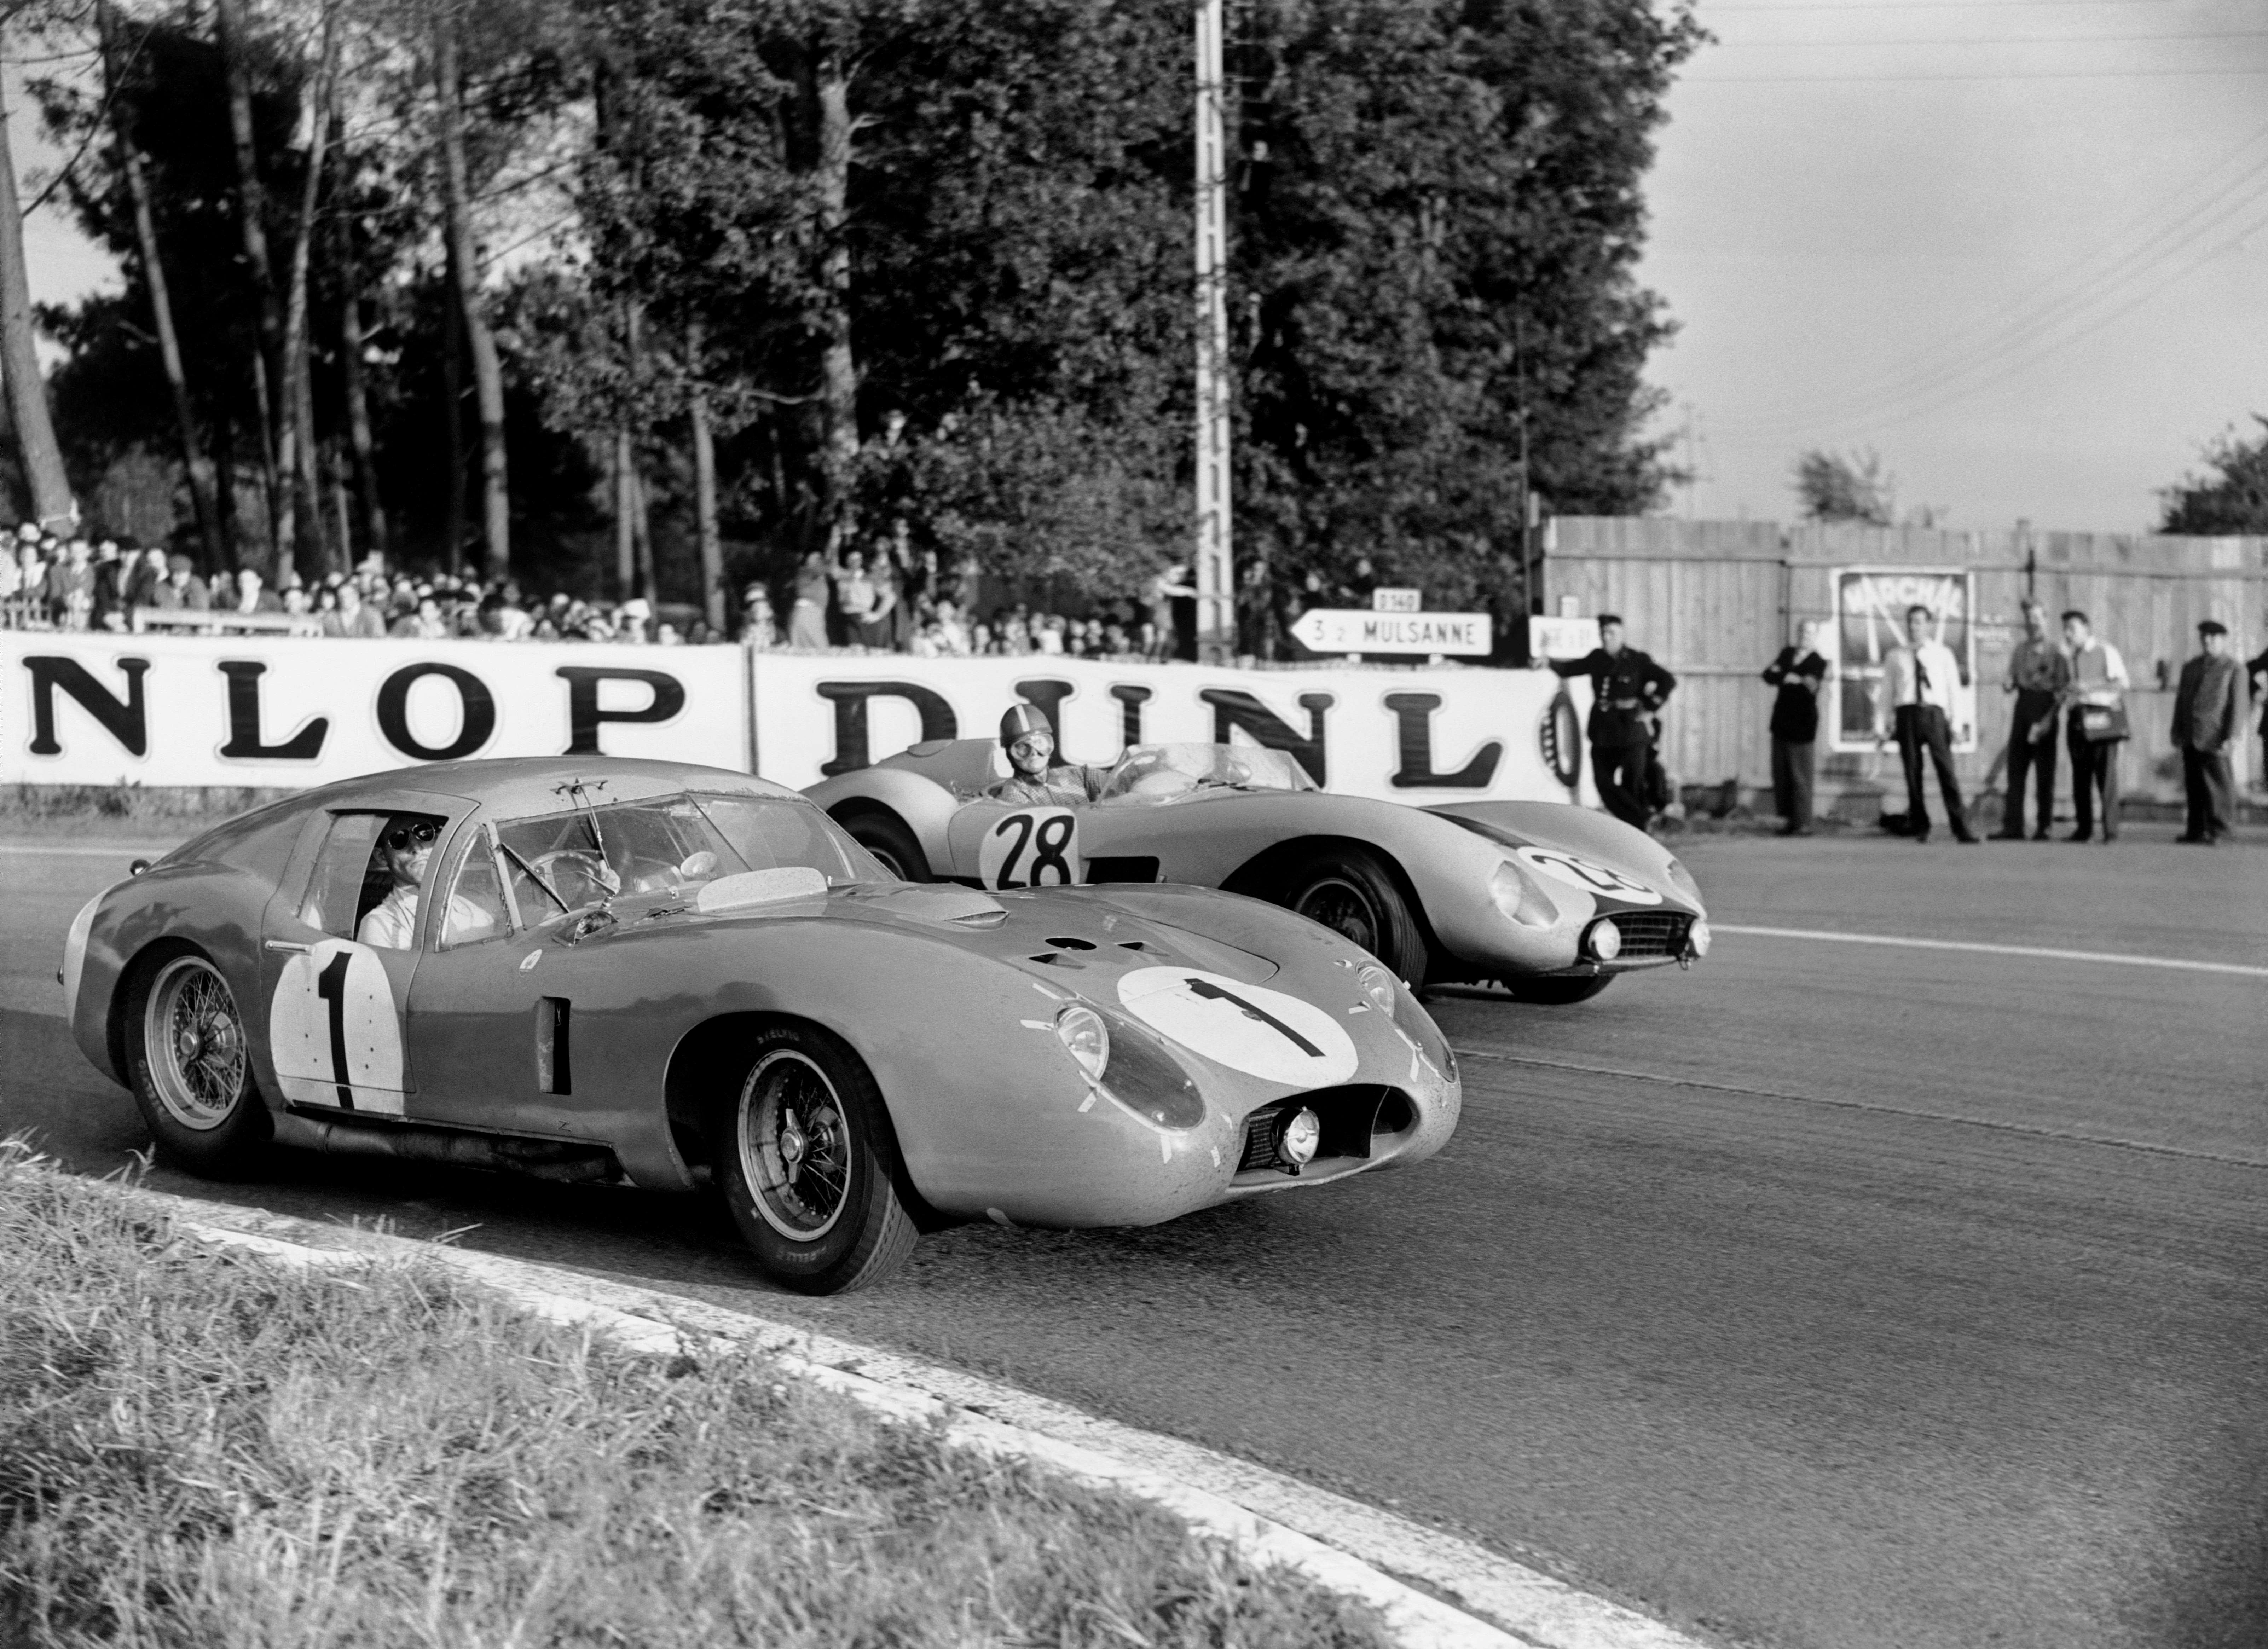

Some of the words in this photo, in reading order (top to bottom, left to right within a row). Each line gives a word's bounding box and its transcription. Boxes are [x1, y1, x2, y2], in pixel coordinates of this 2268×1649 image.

[1363, 620, 1476, 646] MULSANNE
[22, 656, 686, 763] NLOP
[996, 814, 1074, 890] 28
[318, 951, 355, 1109] 1
[1184, 978, 1326, 1057] 1
